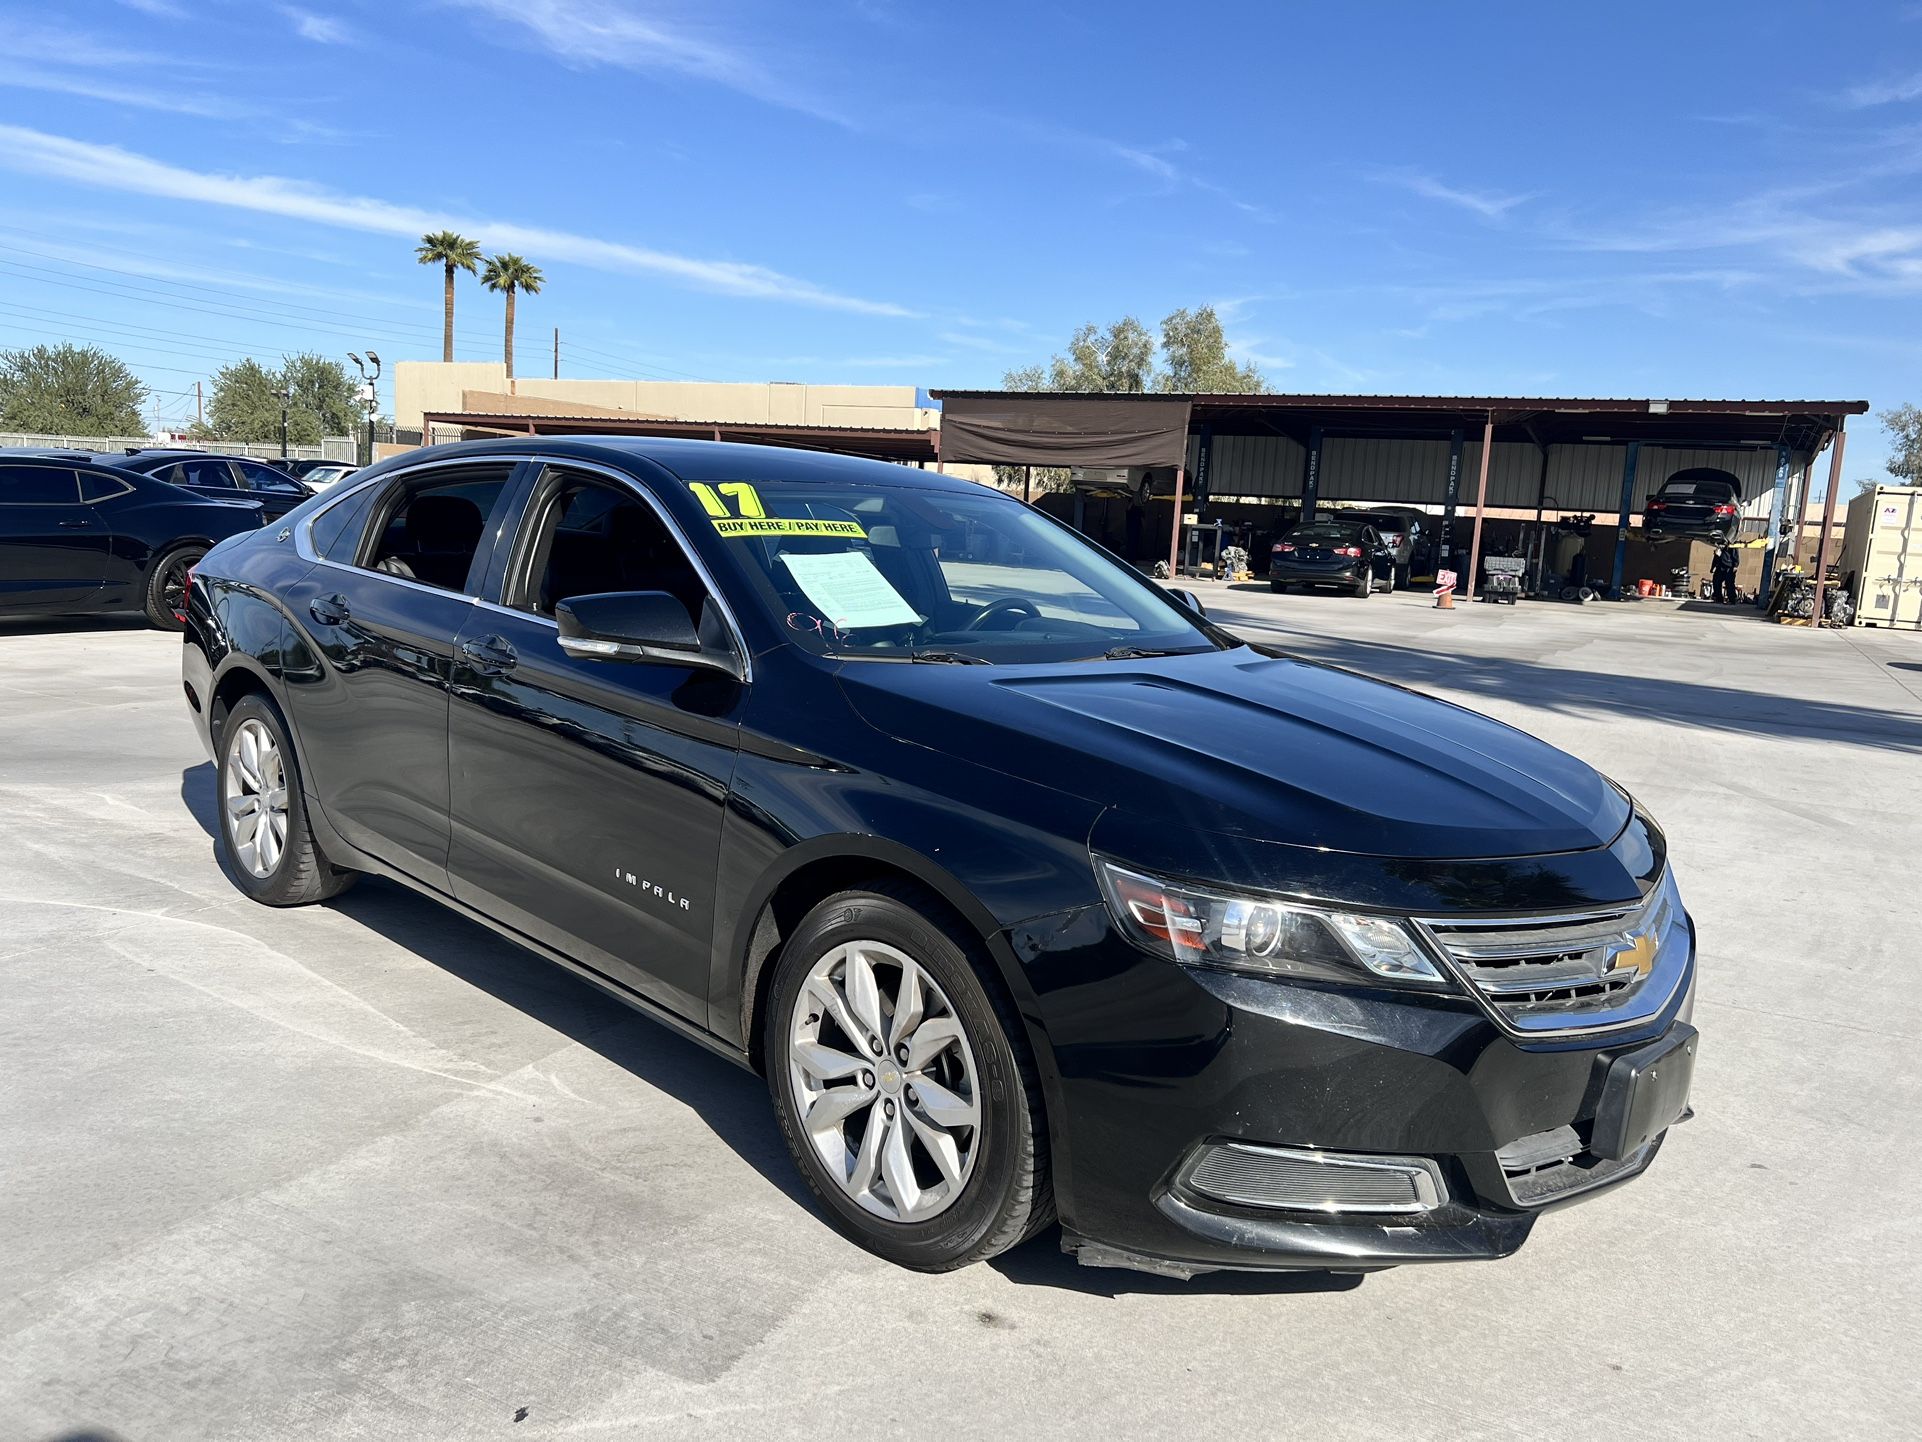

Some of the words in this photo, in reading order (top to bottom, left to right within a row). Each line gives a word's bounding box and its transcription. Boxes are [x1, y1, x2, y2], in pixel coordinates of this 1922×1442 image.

[689, 482, 766, 519] 17
[717, 522, 745, 533] BUY
[748, 521, 784, 532] HERE
[796, 522, 820, 532] PAY
[823, 522, 858, 534] HERE
[615, 868, 690, 911] IMPALA
